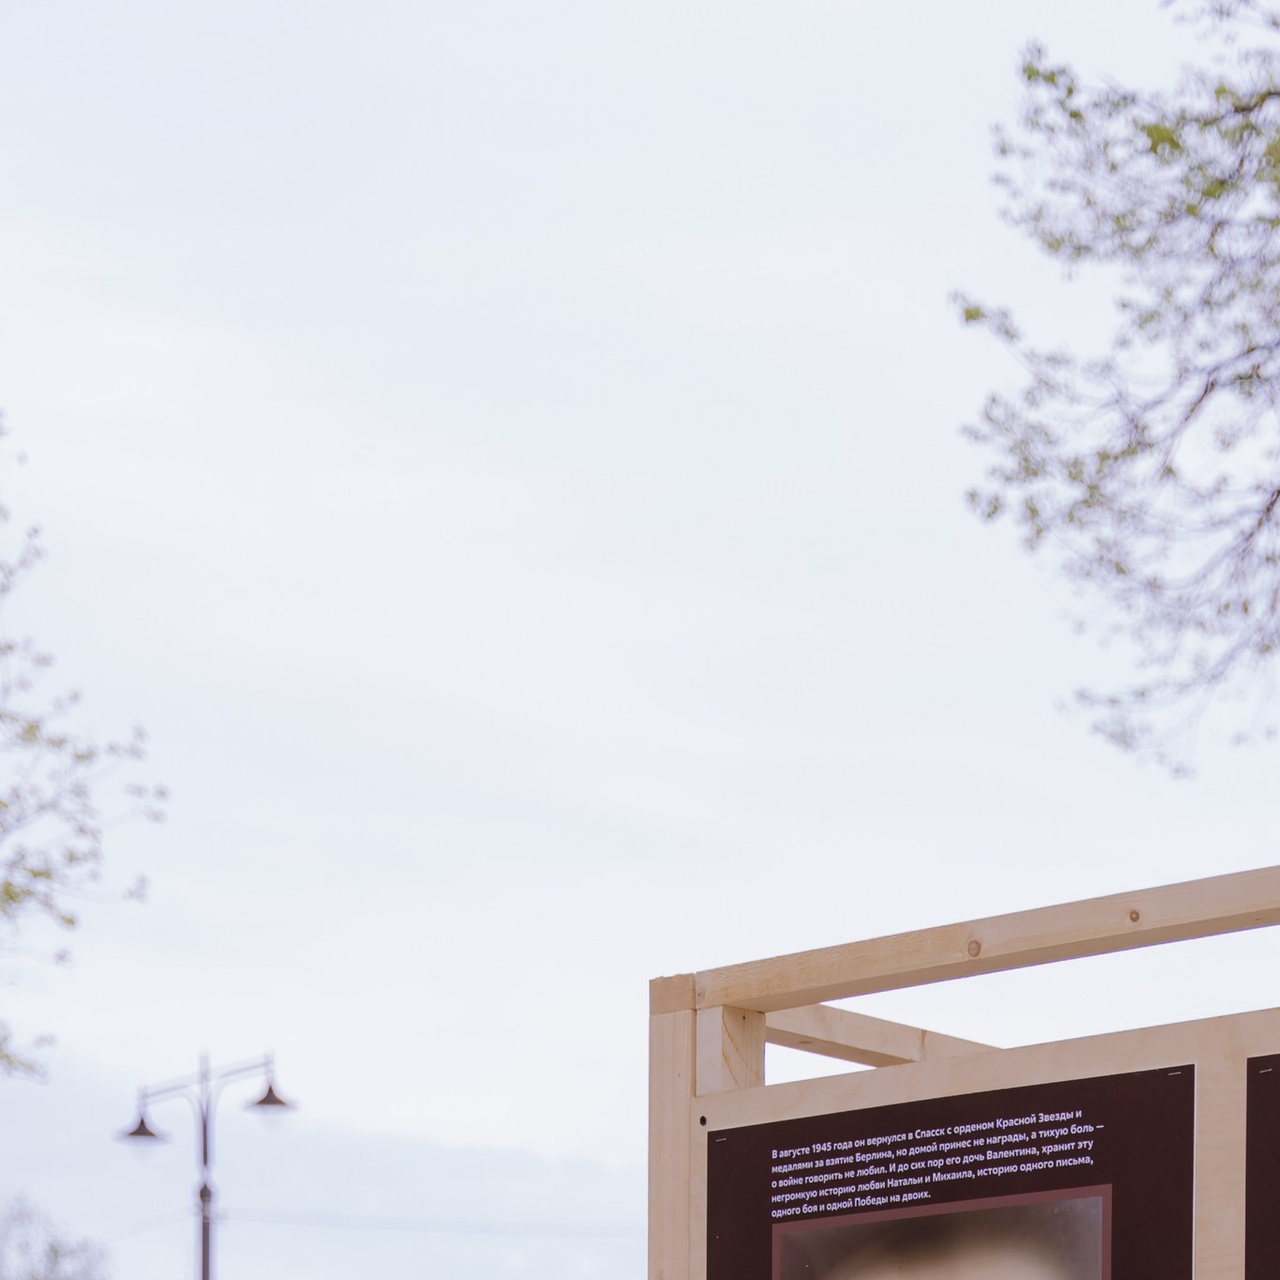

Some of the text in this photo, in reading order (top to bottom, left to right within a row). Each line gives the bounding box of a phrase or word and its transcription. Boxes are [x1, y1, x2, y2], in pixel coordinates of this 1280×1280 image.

[771, 1109, 1082, 1159] В августе 1945 года он вернулся в Спасск с орденом Красной Звезды и
[771, 1160, 813, 1173] медалями
[814, 1159, 824, 1168] за
[824, 1155, 854, 1166] взятие
[854, 1149, 895, 1163] Берлина,
[895, 1147, 908, 1157] но
[908, 1141, 938, 1156] домой
[938, 1139, 972, 1152] принес
[972, 1137, 985, 1146] не
[985, 1132, 1029, 1145] награды,
[1030, 1131, 1037, 1139] а
[1037, 1127, 1069, 1139] тихую
[1069, 1123, 1094, 1134] боль
[770, 1139, 1094, 1188] о войне говорить не любил. И до сих пор его дочь Валентина, хранит эту
[770, 1155, 1094, 1203] негромкую историю любви Натальи и Михаила, историю одного письма,
[770, 1190, 931, 1218] одного боя и одной Победы на двоих.
